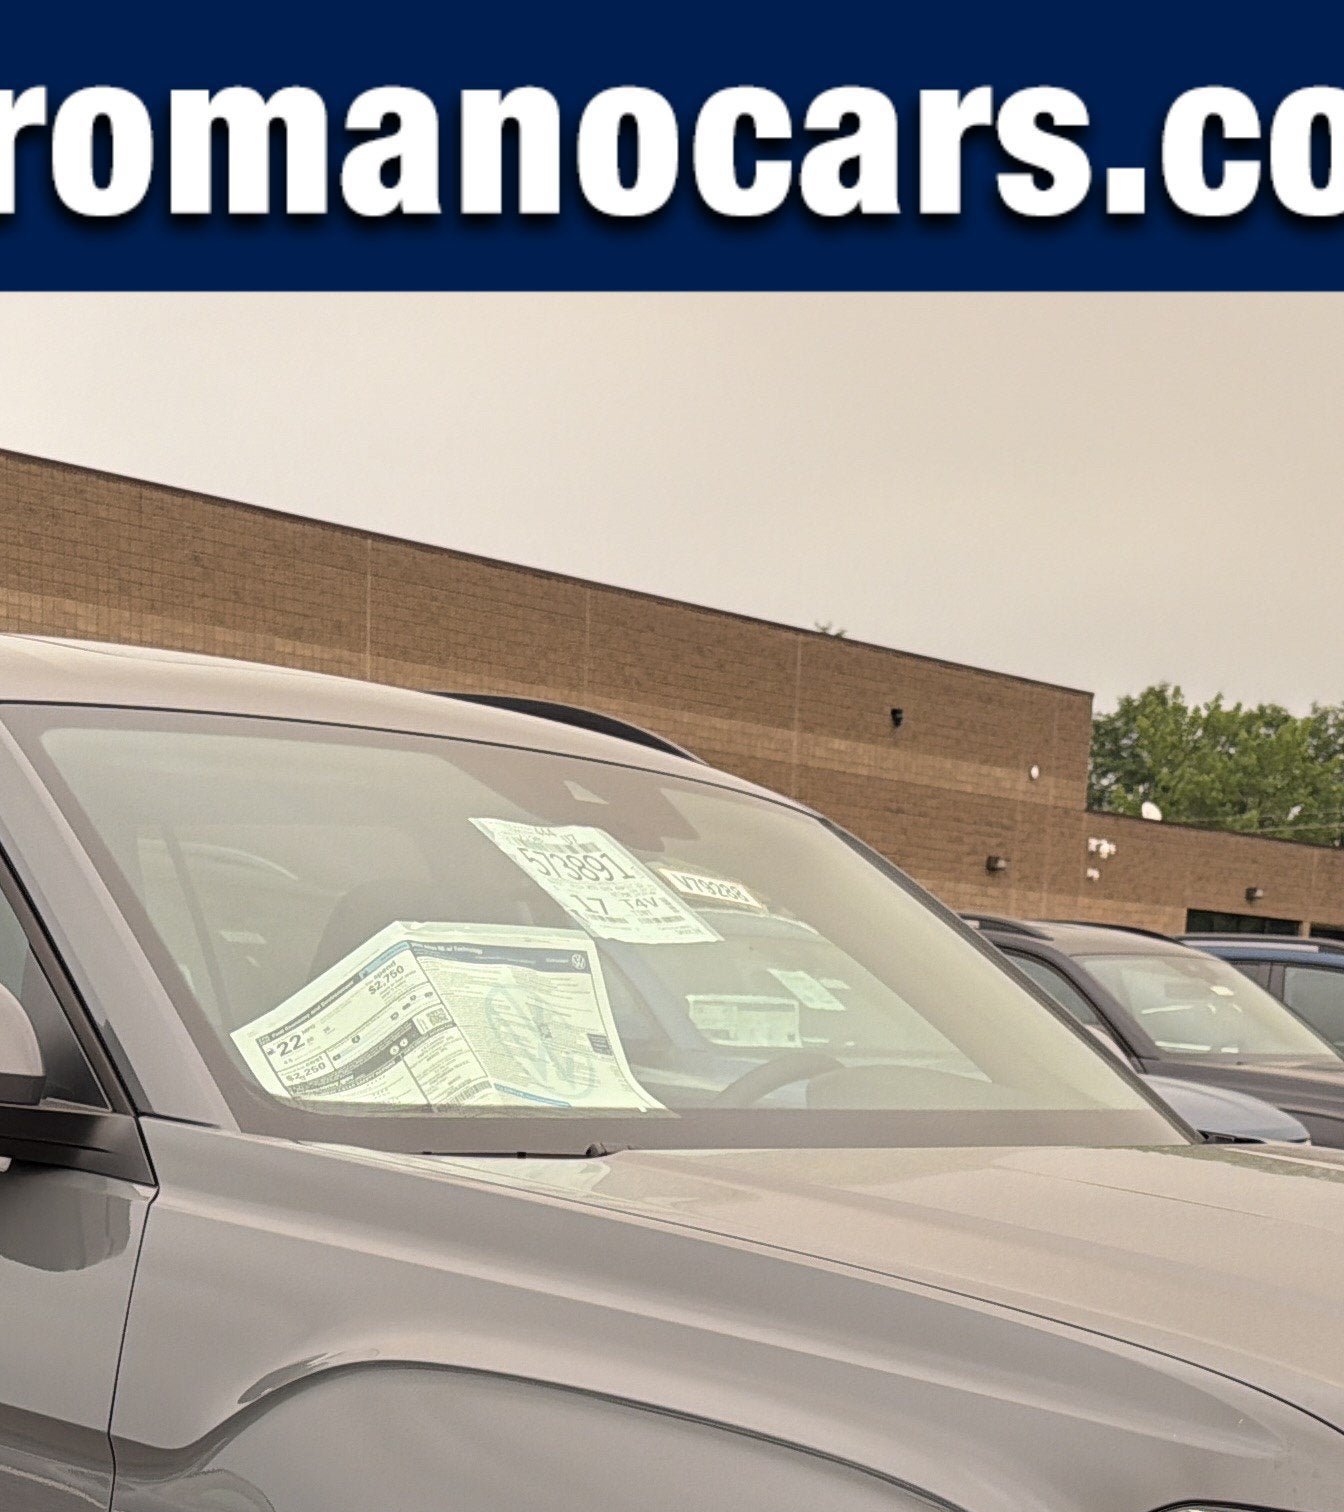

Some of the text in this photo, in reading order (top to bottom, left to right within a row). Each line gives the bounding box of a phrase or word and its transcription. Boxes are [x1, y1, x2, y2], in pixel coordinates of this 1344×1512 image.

[517, 847, 636, 881] 573891
[368, 965, 404, 995] $2,750
[276, 1034, 306, 1057] 22
